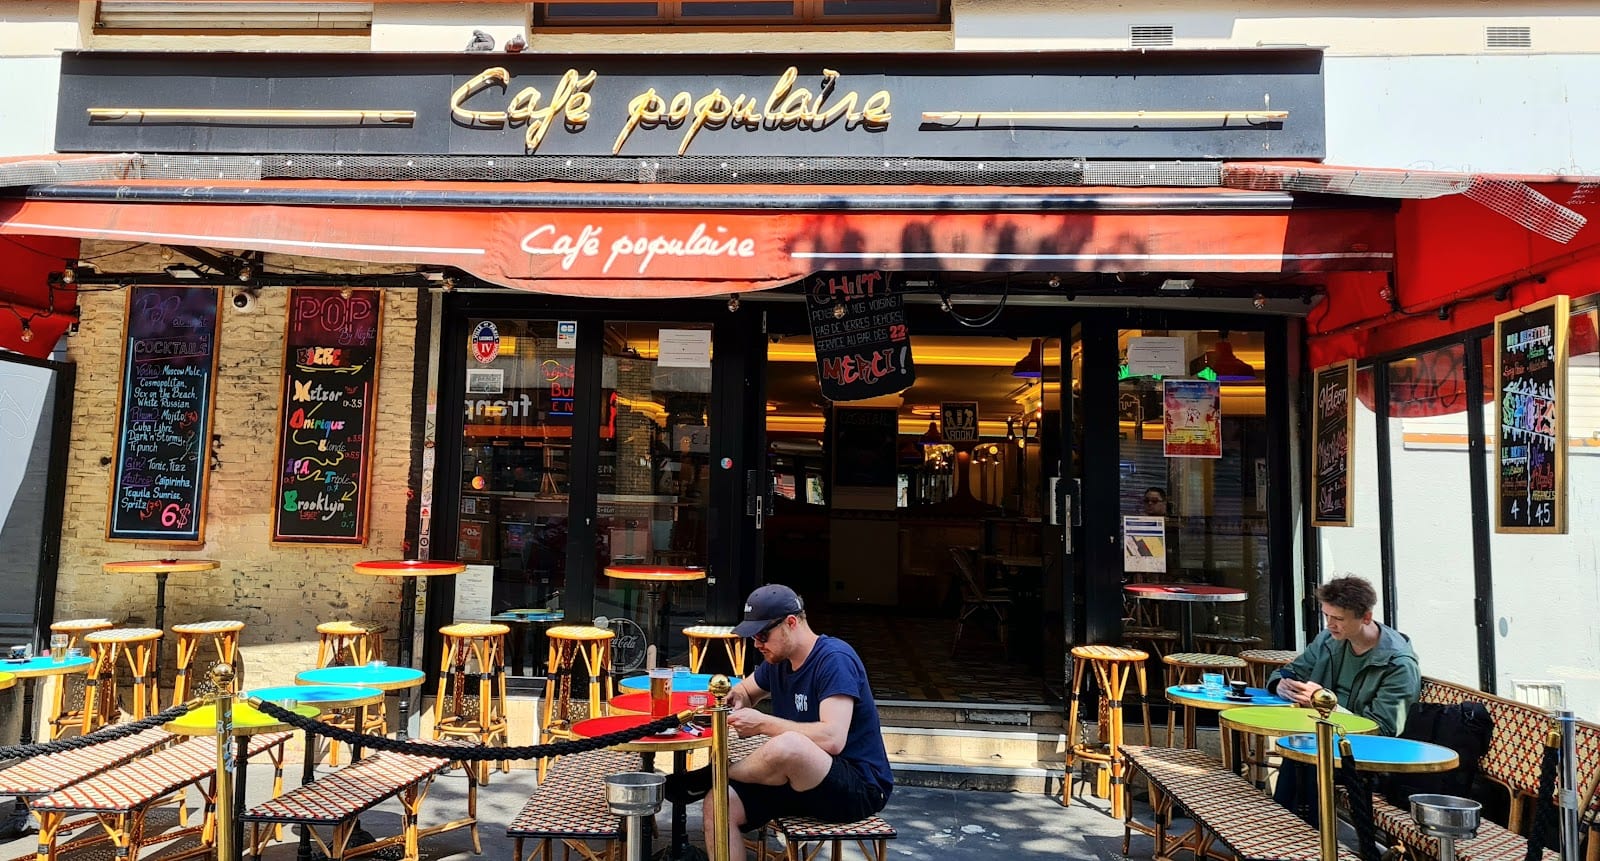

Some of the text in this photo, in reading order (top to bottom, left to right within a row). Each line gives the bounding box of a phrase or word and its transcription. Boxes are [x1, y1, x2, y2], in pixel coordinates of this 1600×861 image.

[450, 66, 892, 155] Café populaire
[520, 223, 755, 272] Café populaire
[294, 296, 372, 332] POP
[815, 324, 830, 336] PAS
[831, 322, 841, 333] DE
[134, 340, 208, 355] COCKTAILS
[481, 343, 493, 353] IV
[162, 364, 185, 376] Moscow
[822, 345, 908, 386] MERCI !
[133, 387, 149, 398] Sex
[159, 388, 171, 398] the
[137, 397, 190, 408] White Russian
[132, 421, 152, 432] Cuba
[289, 407, 346, 438] Onirique
[122, 486, 151, 502] Tequila
[121, 497, 148, 513] Spritz
[283, 490, 345, 521] Brooklyn
[1510, 499, 1520, 520] 4
